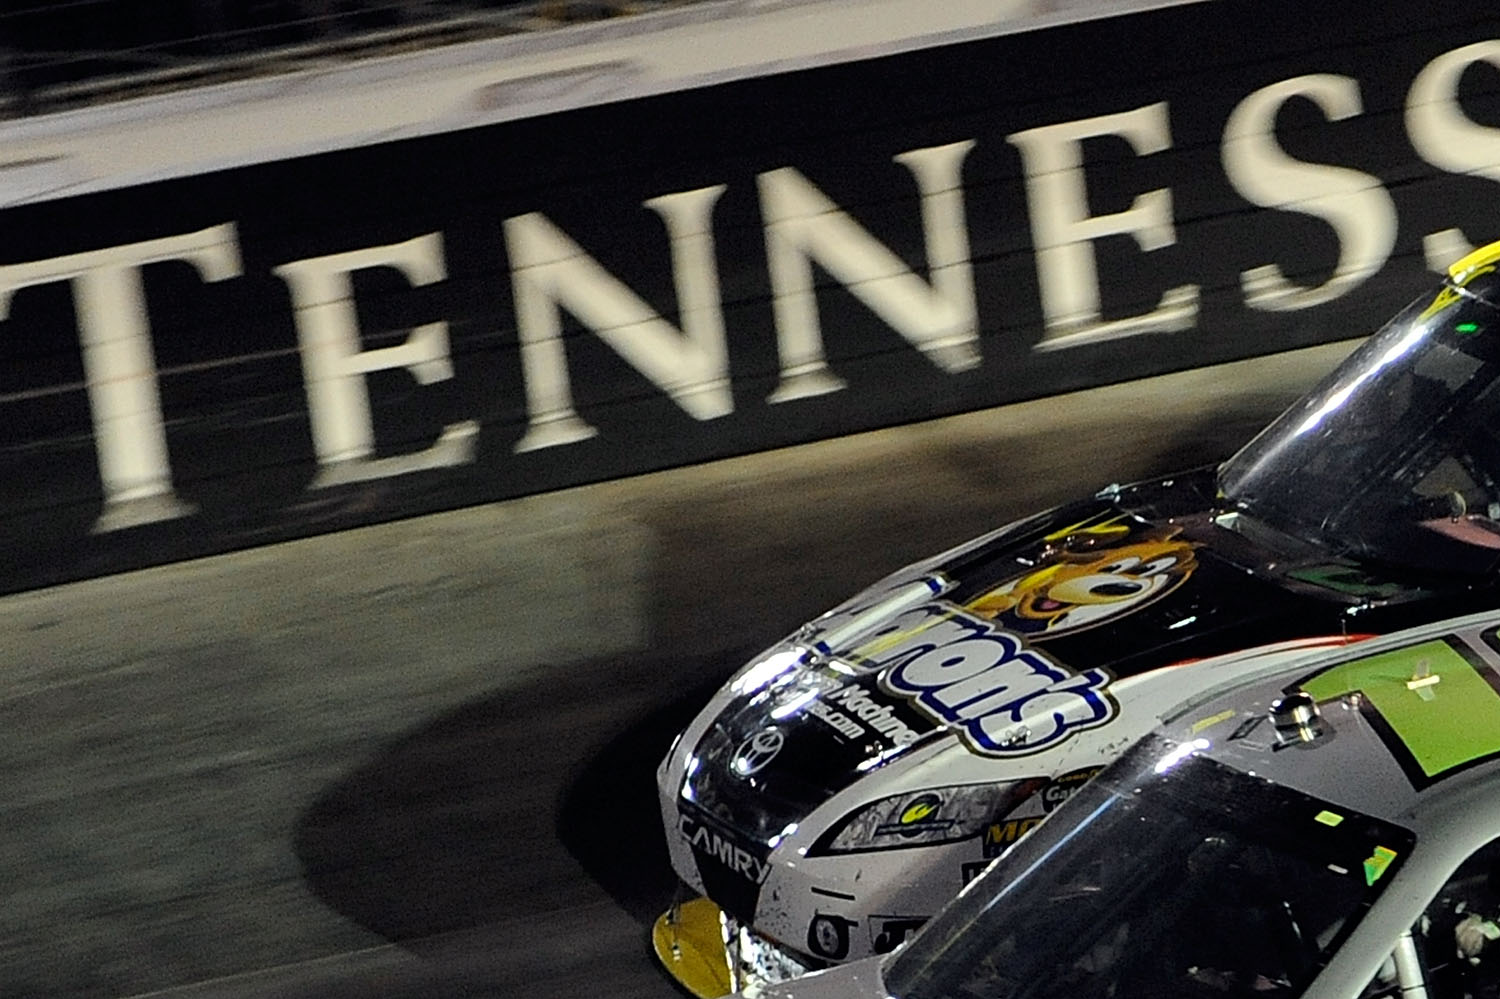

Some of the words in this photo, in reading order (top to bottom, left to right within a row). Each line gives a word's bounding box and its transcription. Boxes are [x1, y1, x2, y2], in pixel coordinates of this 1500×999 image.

[800, 600, 1110, 755] aron's
[837, 683, 922, 749] Machine
[677, 813, 773, 885] CAMRY
